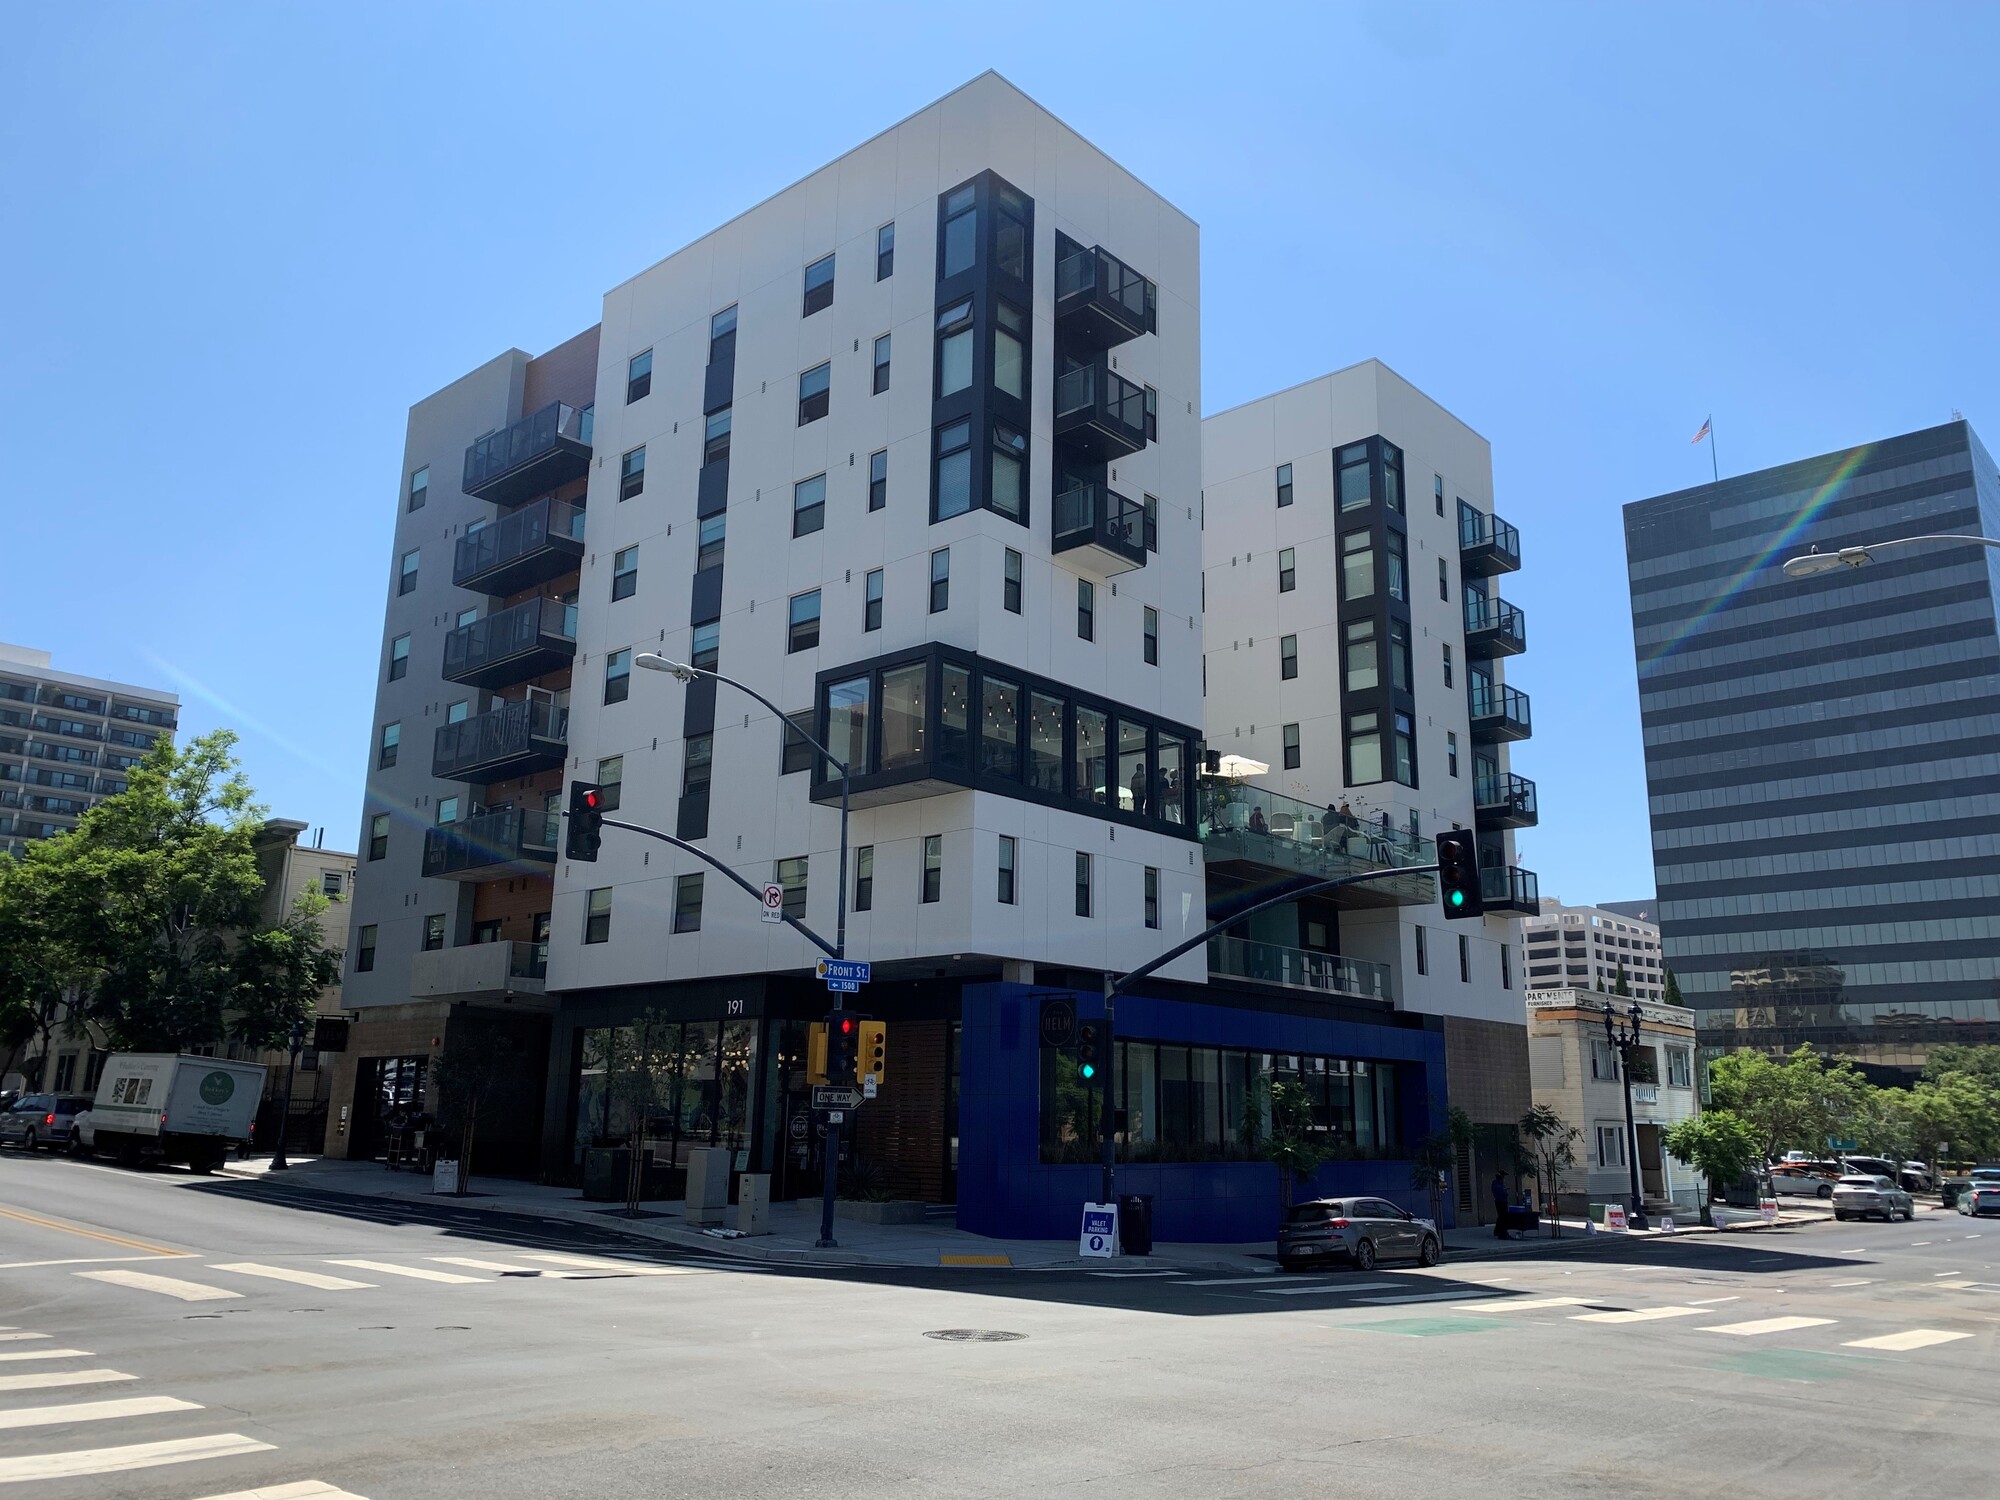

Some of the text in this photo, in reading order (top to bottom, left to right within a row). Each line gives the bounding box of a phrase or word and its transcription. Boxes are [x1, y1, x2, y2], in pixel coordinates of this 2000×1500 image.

[771, 911, 780, 919] RED
[841, 981, 855, 990] 1500
[1525, 991, 1573, 1001] PARTMENTS
[727, 999, 744, 1015] 191
[1045, 1016, 1071, 1031] HELM
[819, 1093, 851, 1102] ONE WAY
[1091, 1219, 1106, 1227] VALET
[1088, 1226, 1109, 1234] PARKING
